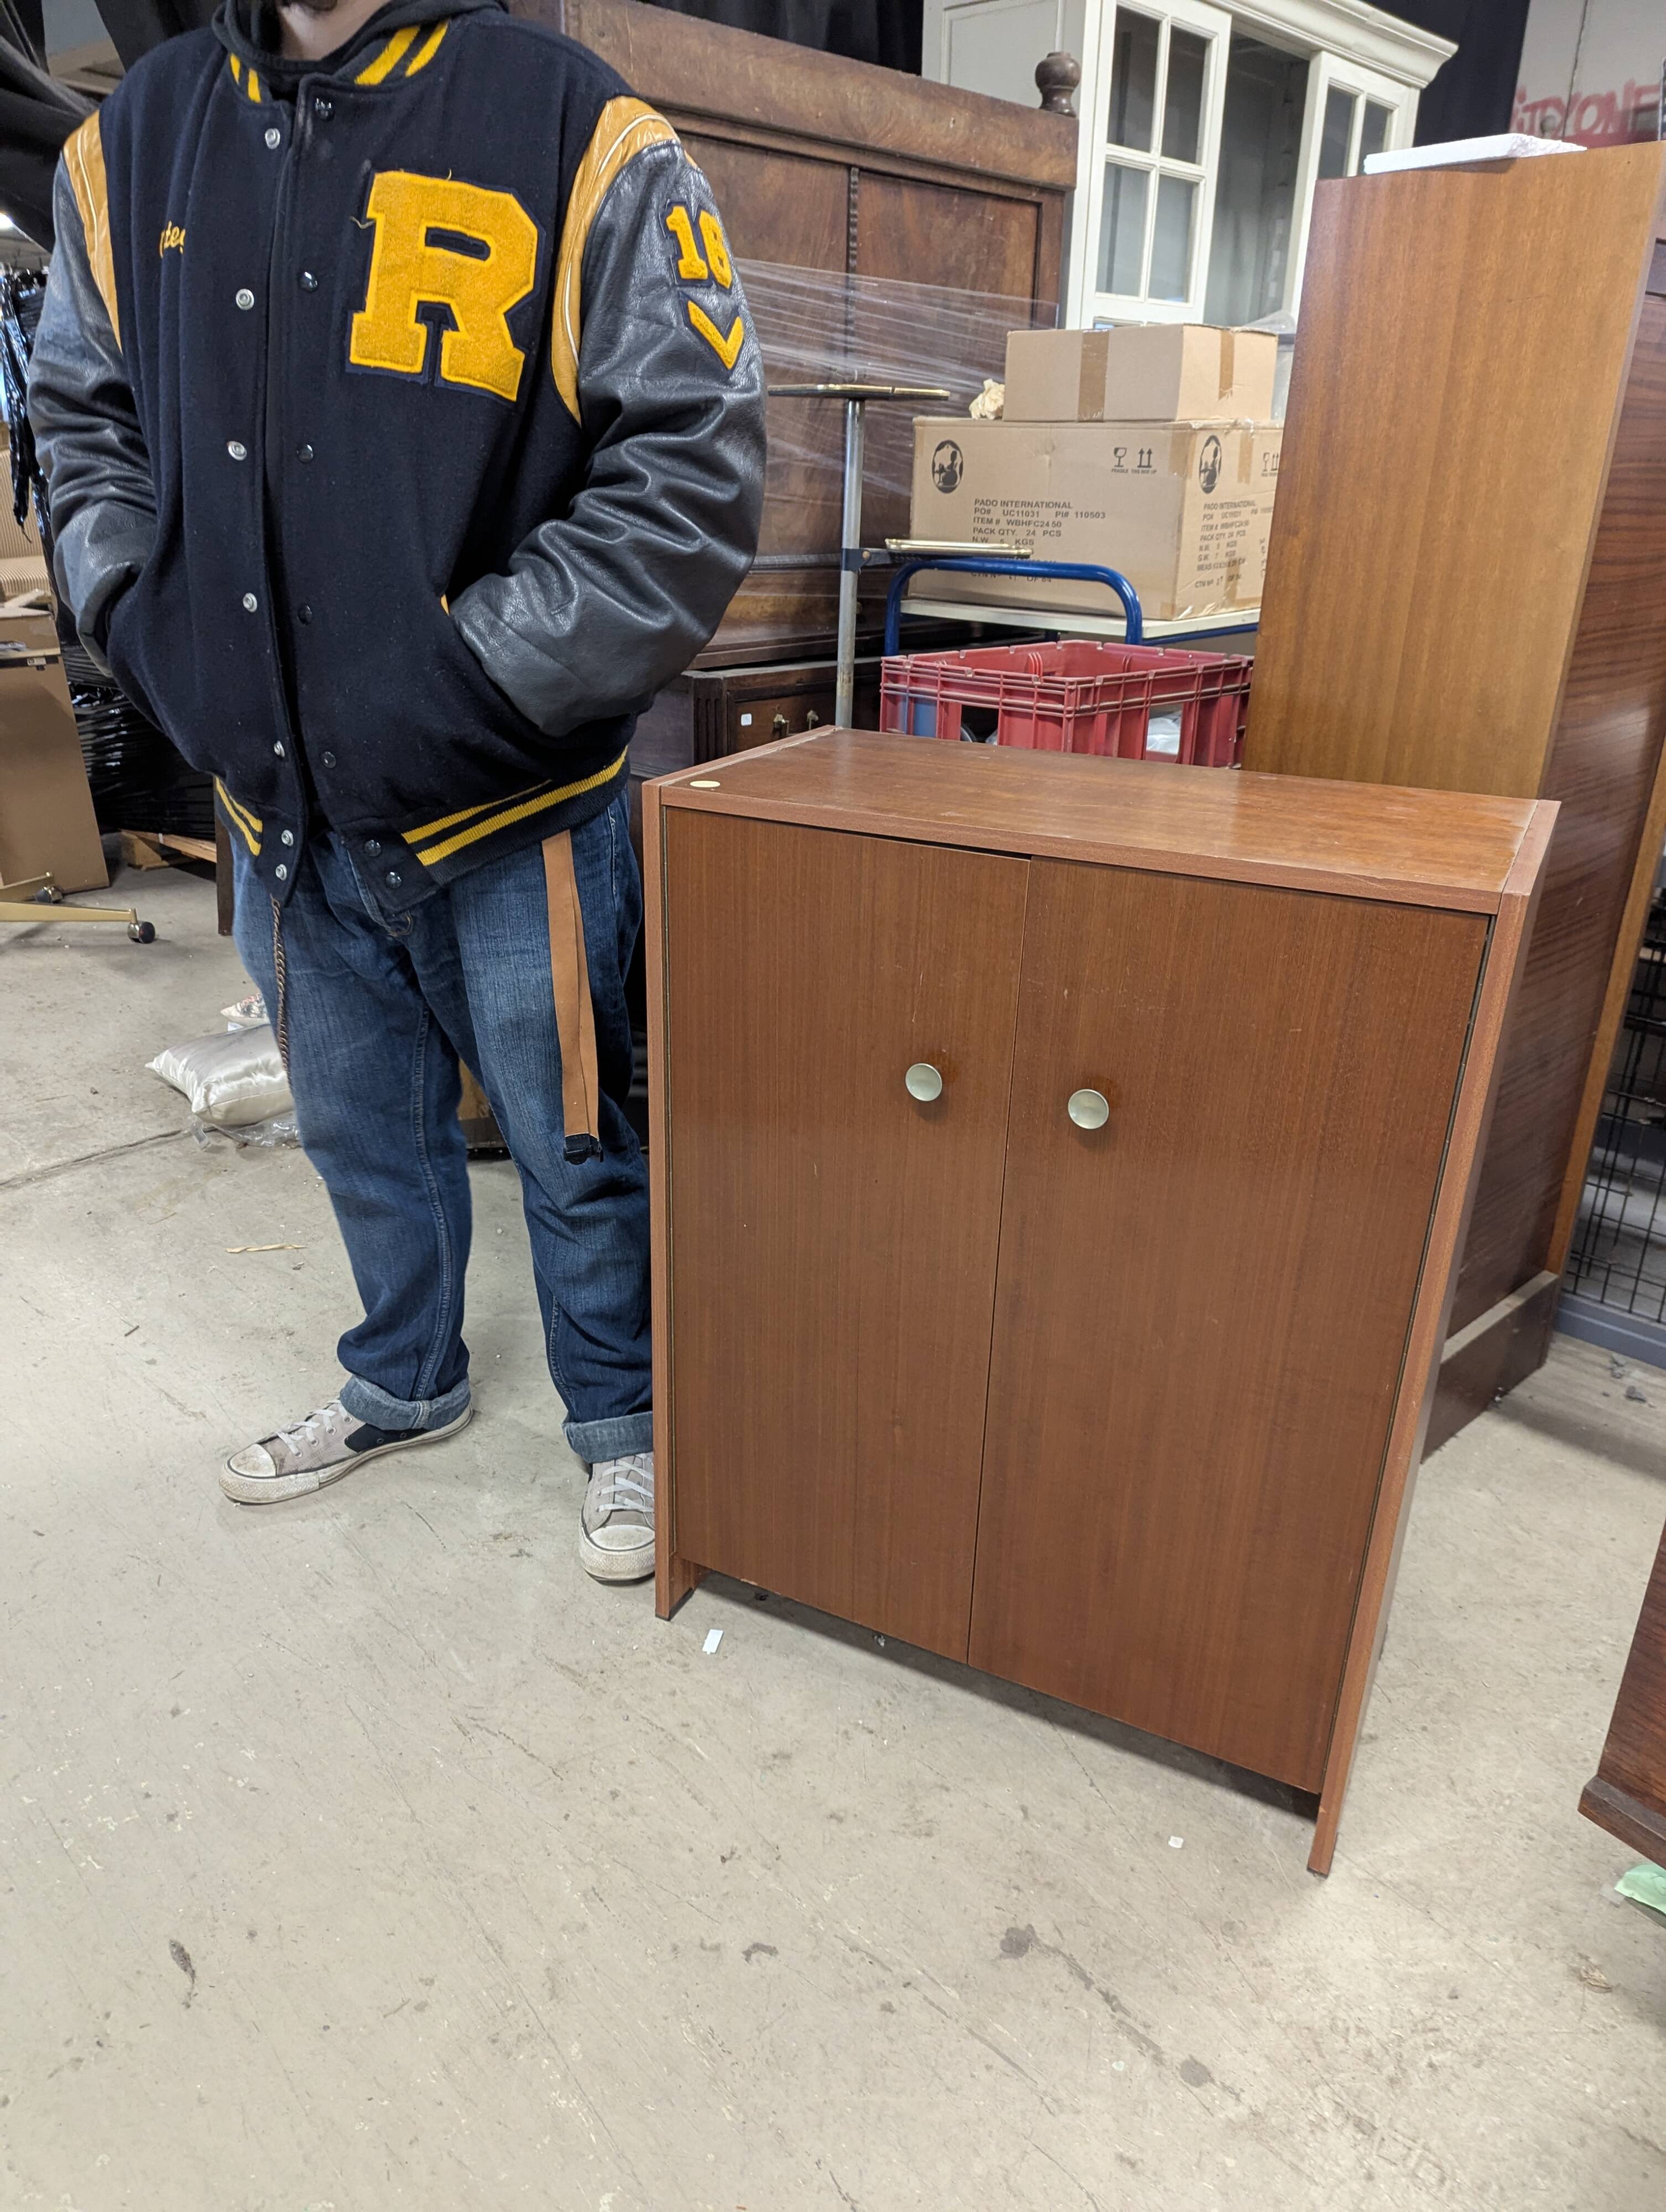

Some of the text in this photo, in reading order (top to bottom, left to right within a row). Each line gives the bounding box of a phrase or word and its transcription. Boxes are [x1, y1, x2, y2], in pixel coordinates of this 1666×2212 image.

[666, 206, 732, 289] 18
[350, 171, 539, 401] R
[974, 498, 1074, 509] PADO INTERNATIONAL
[1219, 500, 1256, 509] INTERNATIONAL
[1002, 509, 1040, 518] UC11031
[973, 517, 993, 525] ITEM
[973, 527, 996, 535] PACK
